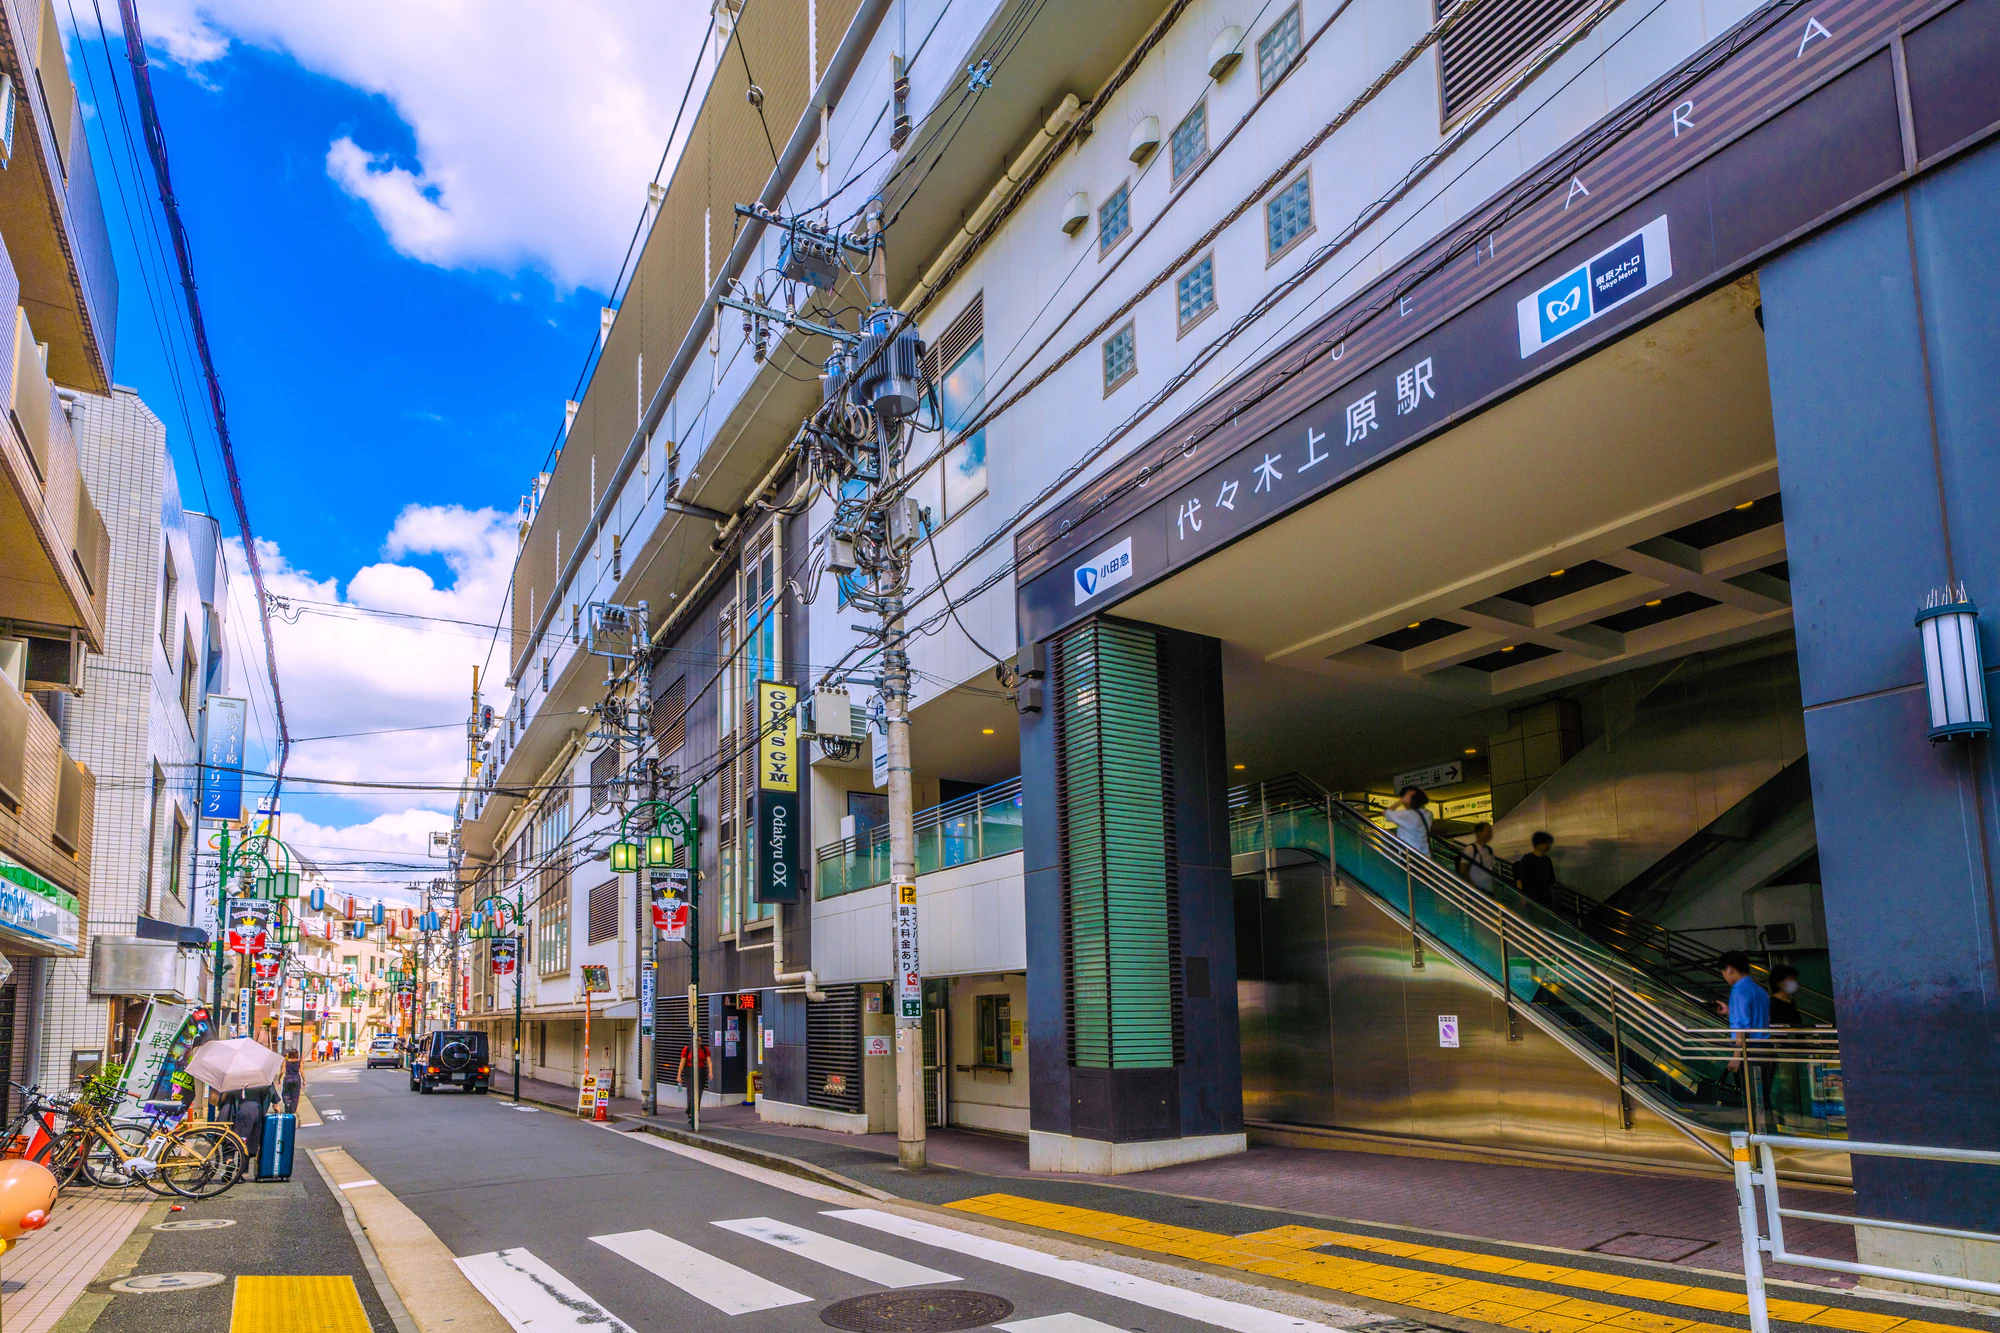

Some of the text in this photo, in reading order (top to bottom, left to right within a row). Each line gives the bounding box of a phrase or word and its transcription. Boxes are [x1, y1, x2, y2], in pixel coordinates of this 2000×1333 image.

[1595, 254, 1640, 287] 東京メトロ
[1599, 266, 1638, 292] Tokyo Metro
[1177, 356, 1436, 541] 代々木上原駅
[1100, 552, 1130, 578] 小田急
[225, 713, 240, 764] 代々木上原
[769, 690, 789, 784] GOLD'S GYM
[209, 733, 222, 812] こどもクリニック
[769, 805, 787, 888] Odakyu OX
[899, 906, 911, 971] 最大料金あり
[157, 1020, 178, 1032] THE
[740, 995, 754, 1009] 満
